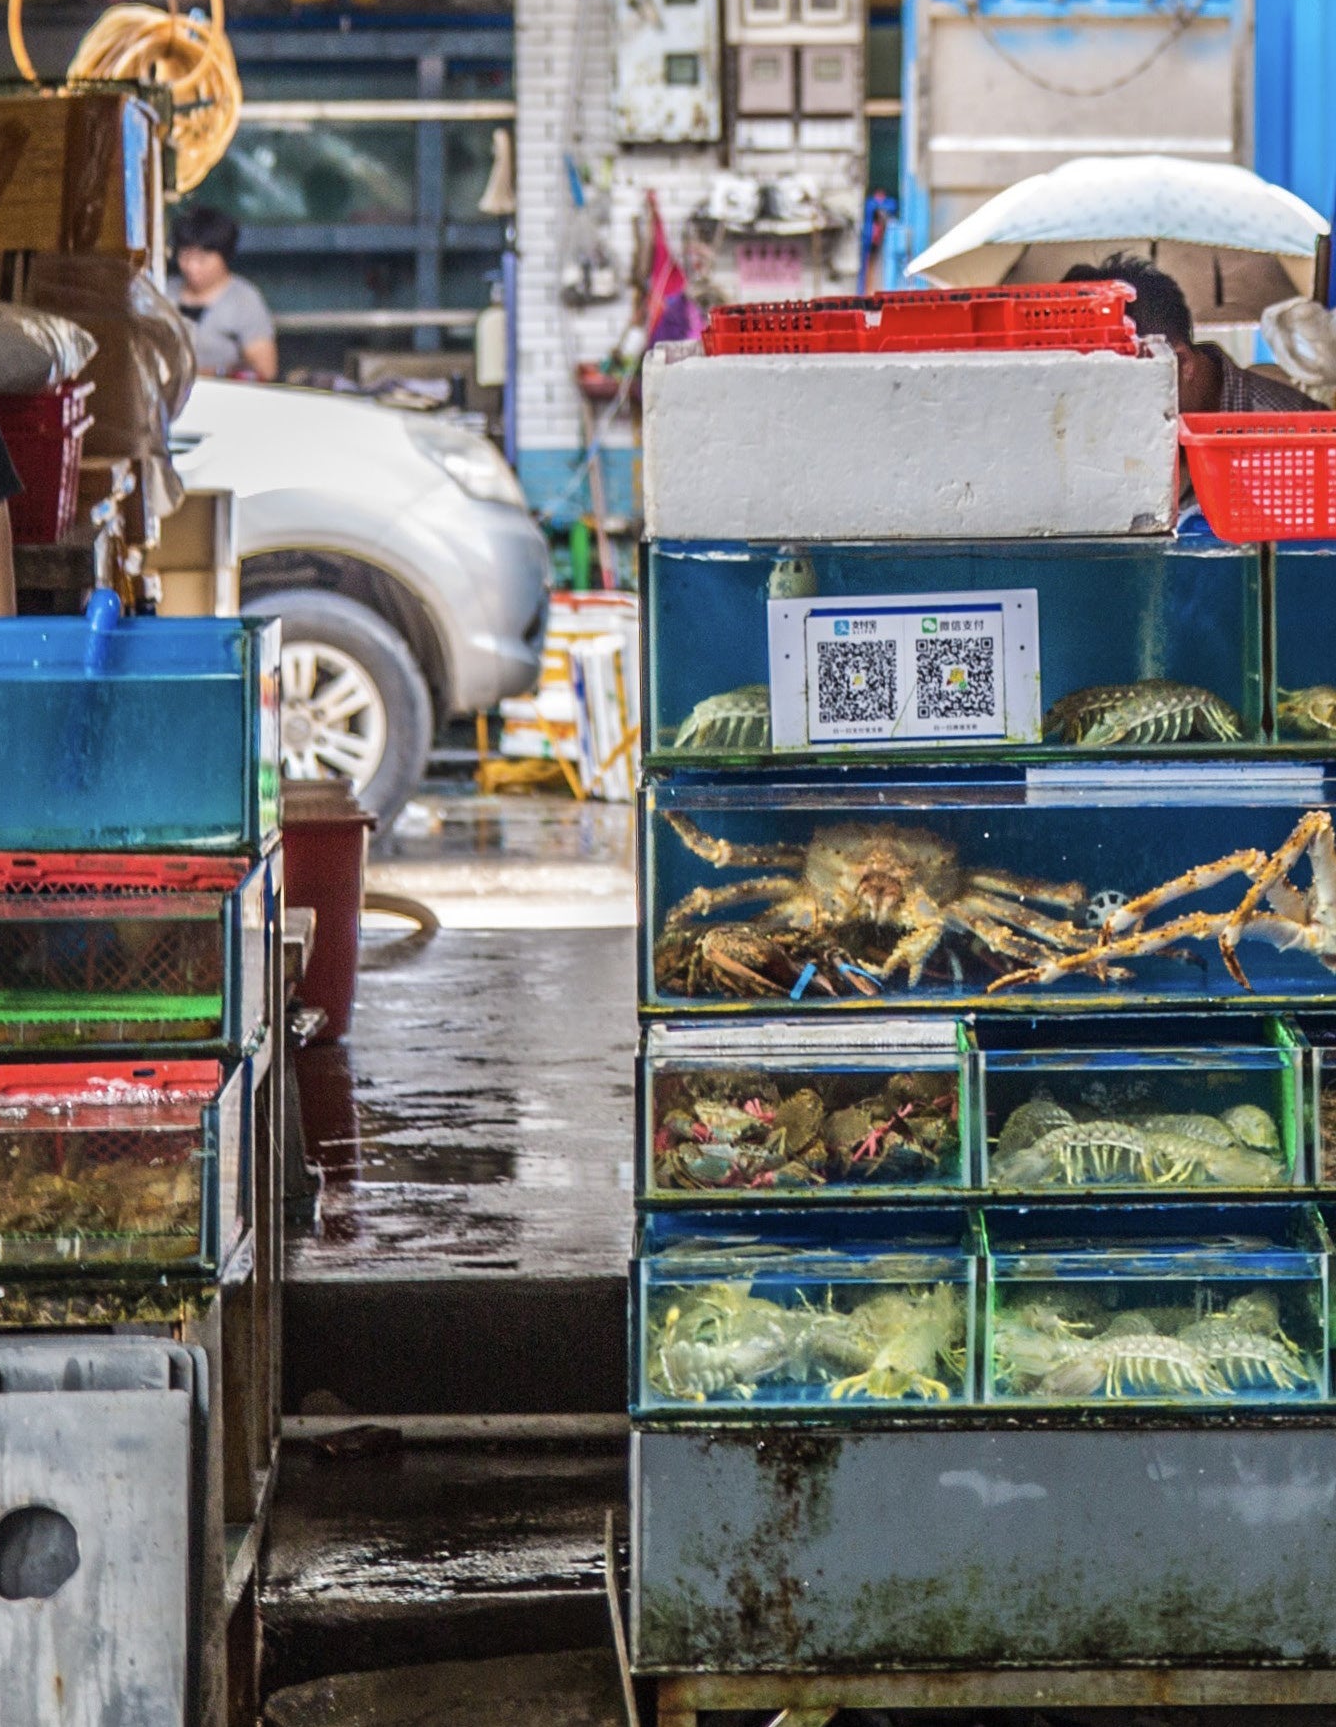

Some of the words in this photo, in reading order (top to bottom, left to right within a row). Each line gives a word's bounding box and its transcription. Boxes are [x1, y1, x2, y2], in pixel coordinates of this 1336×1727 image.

[852, 619, 878, 631] 支付宝
[939, 618, 985, 632] 微信支付
